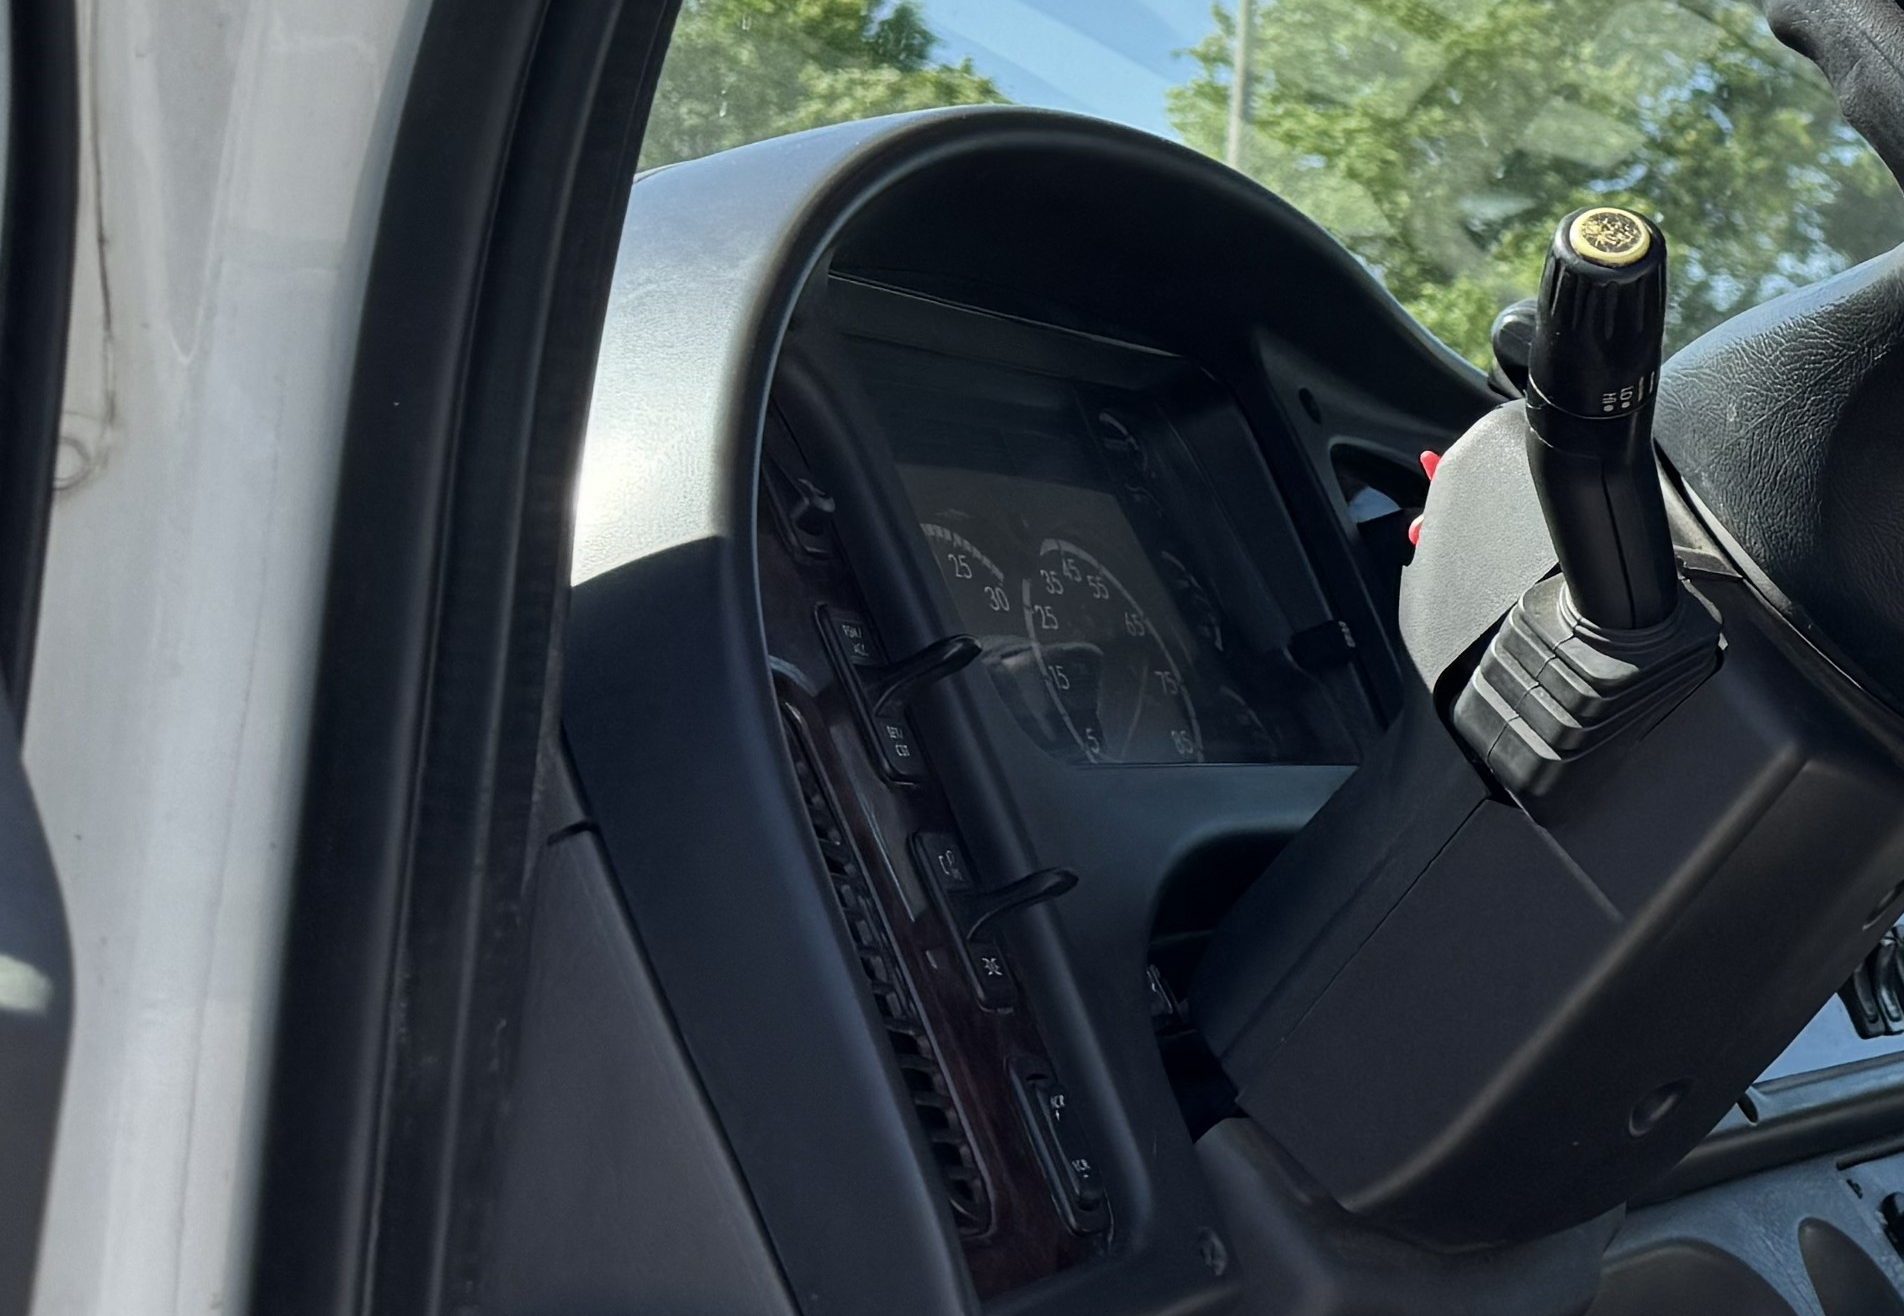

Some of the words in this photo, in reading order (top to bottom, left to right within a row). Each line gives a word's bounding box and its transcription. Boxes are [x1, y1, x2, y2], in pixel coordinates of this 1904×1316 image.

[948, 553, 973, 580] 25
[1061, 558, 1083, 583] 45
[1040, 569, 1065, 596] 35
[1086, 575, 1110, 600] 55
[984, 586, 1010, 612] 30
[1034, 604, 1059, 630] 25
[1124, 612, 1146, 637] 65
[1048, 665, 1070, 690] 15
[1154, 670, 1179, 696] 75
[1085, 728, 1100, 753] 5
[1171, 730, 1195, 755] 85
